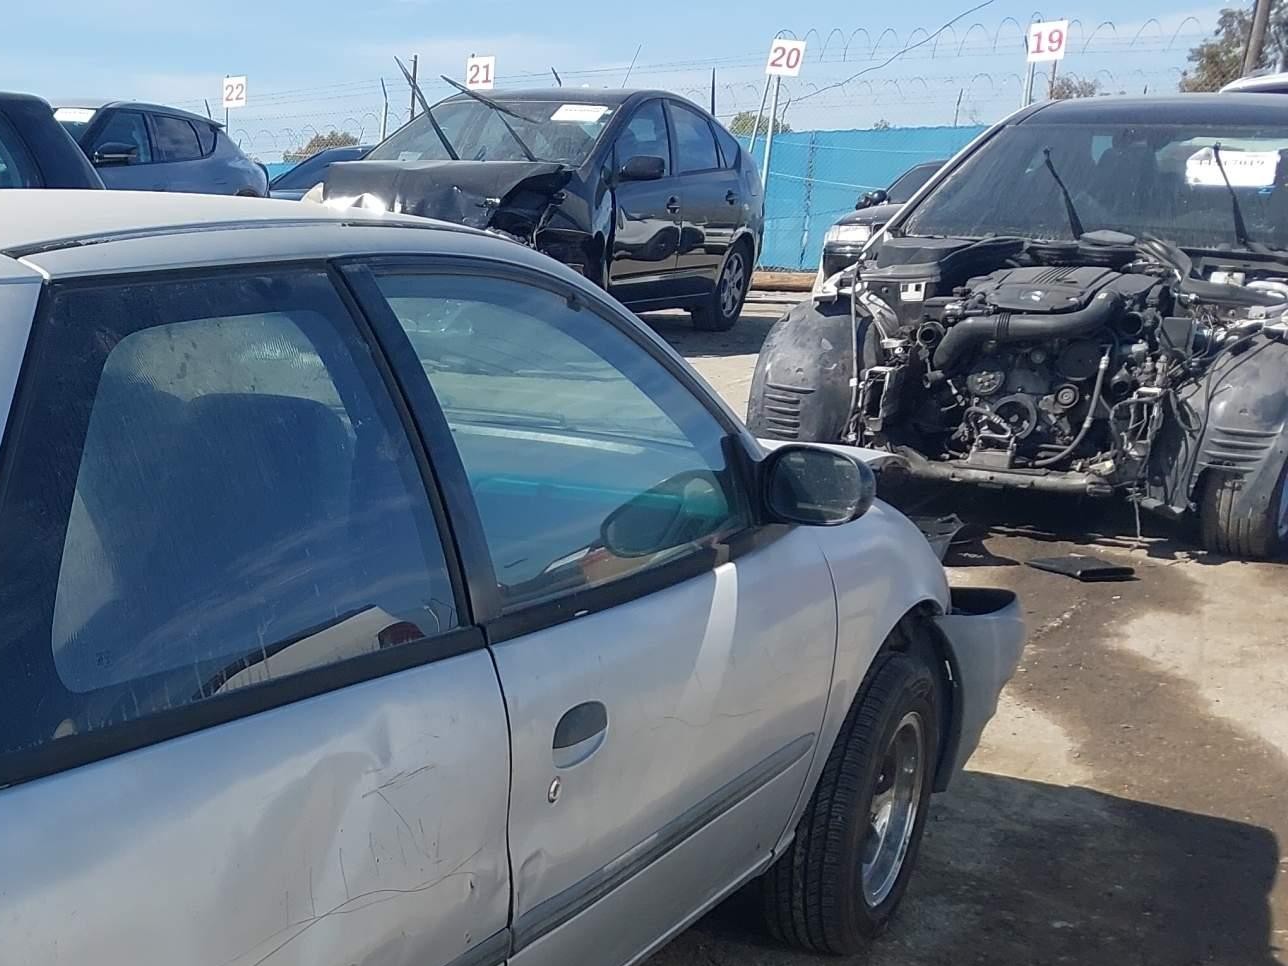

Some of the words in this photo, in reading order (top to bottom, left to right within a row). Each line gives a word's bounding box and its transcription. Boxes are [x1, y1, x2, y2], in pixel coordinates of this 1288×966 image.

[1031, 30, 1063, 53] 19
[770, 47, 800, 68] 20
[469, 64, 491, 84] 21
[225, 84, 244, 101] 22
